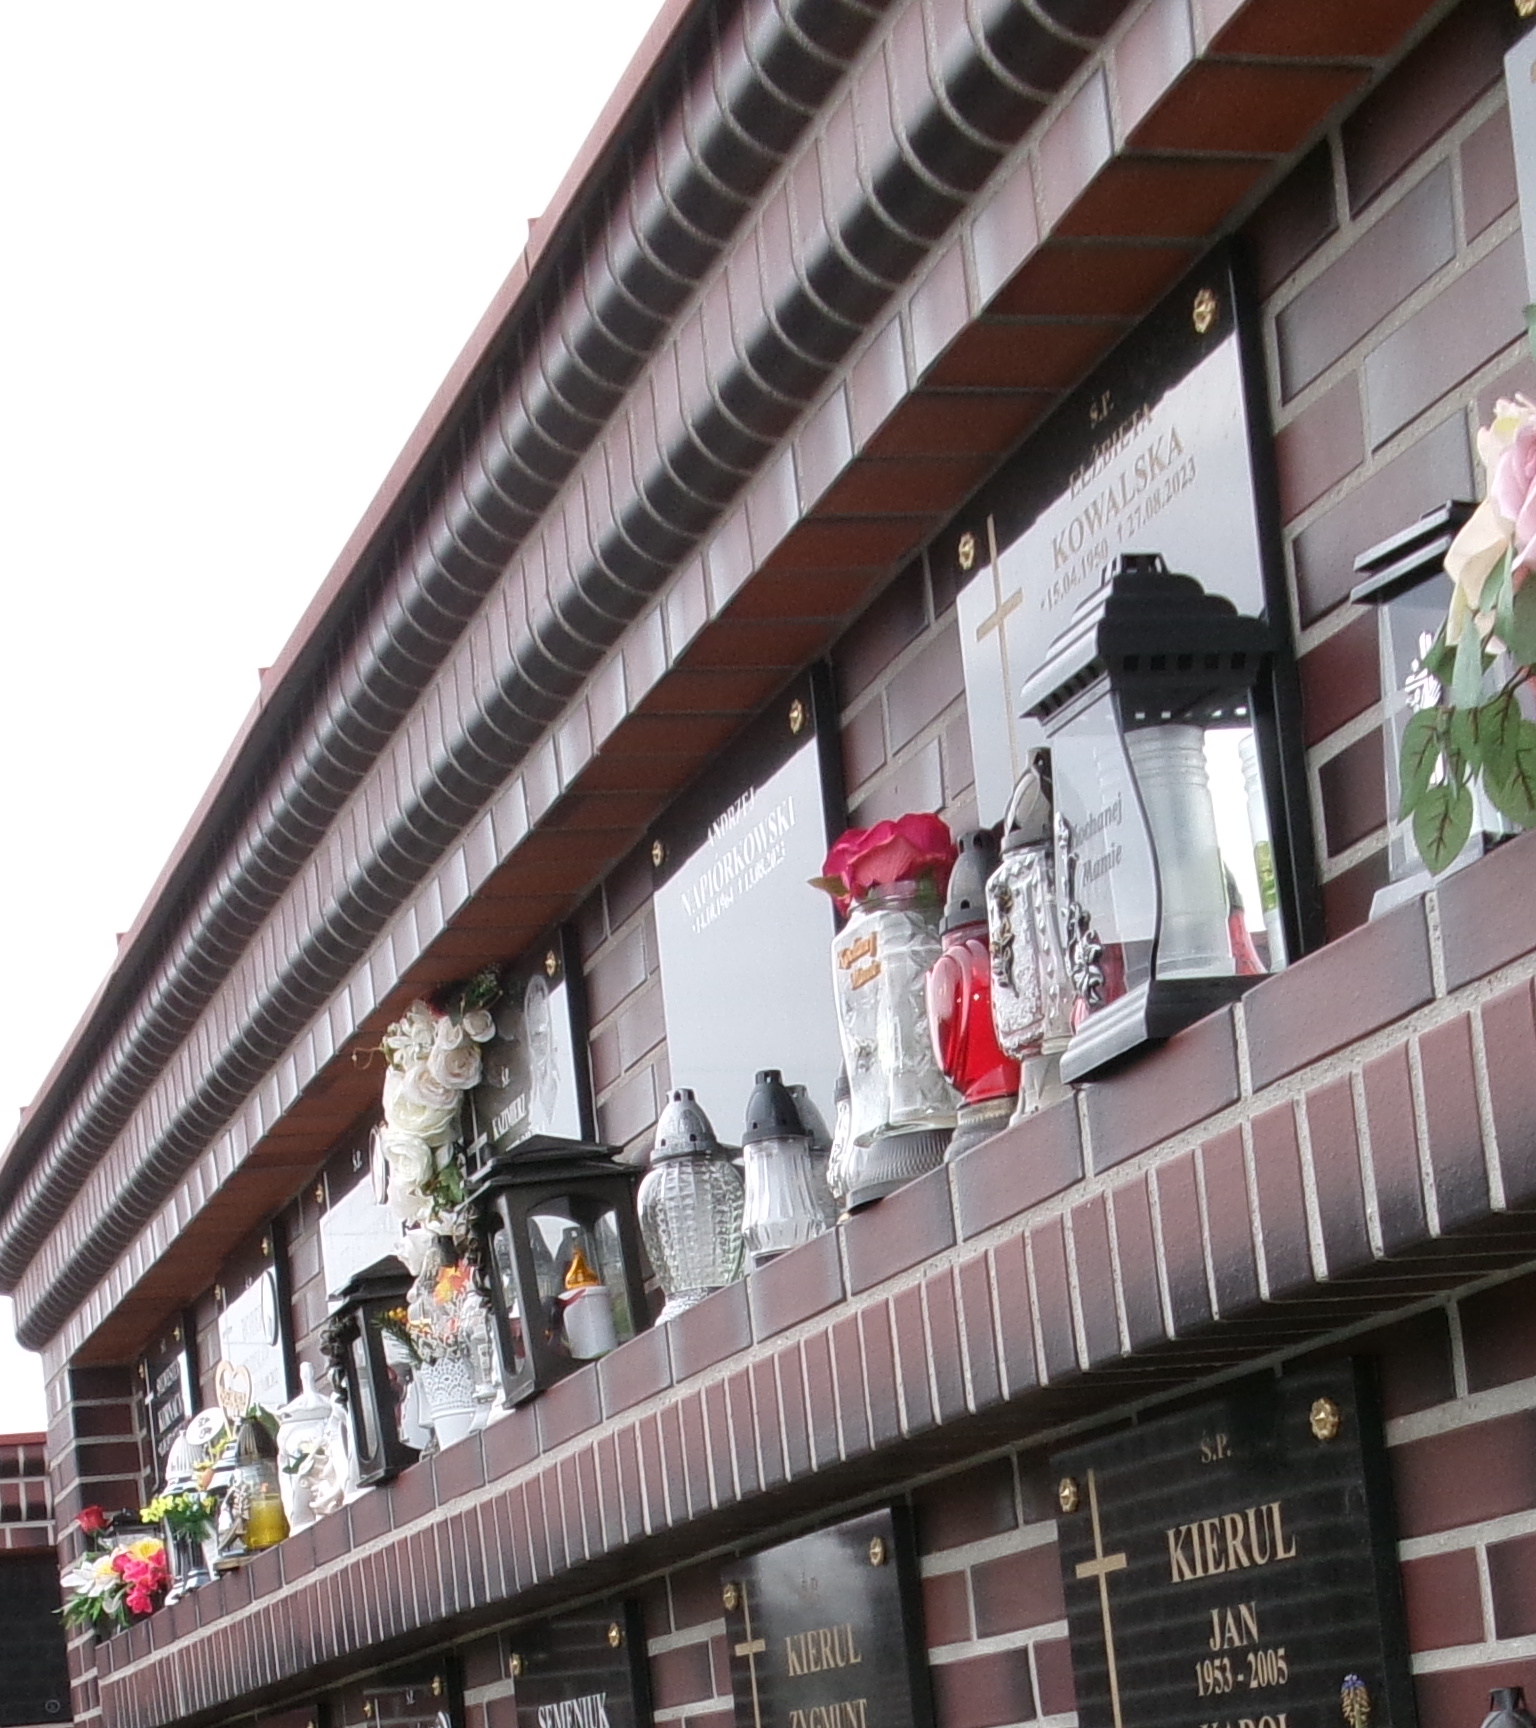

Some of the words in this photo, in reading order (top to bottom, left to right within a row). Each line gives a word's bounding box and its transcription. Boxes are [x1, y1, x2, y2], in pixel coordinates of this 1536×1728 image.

[1051, 425, 1185, 571] KOWALSKA
[680, 795, 796, 917] NAPIÓRKOWSKI
[1200, 1430, 1232, 1464] Ś.P.
[1166, 1501, 1296, 1583] KIERUL
[784, 1622, 862, 1677] KIERUL
[1208, 1601, 1259, 1652] JAN
[1195, 1658, 1233, 1697] 1953
[1246, 1648, 1289, 1690] 2005
